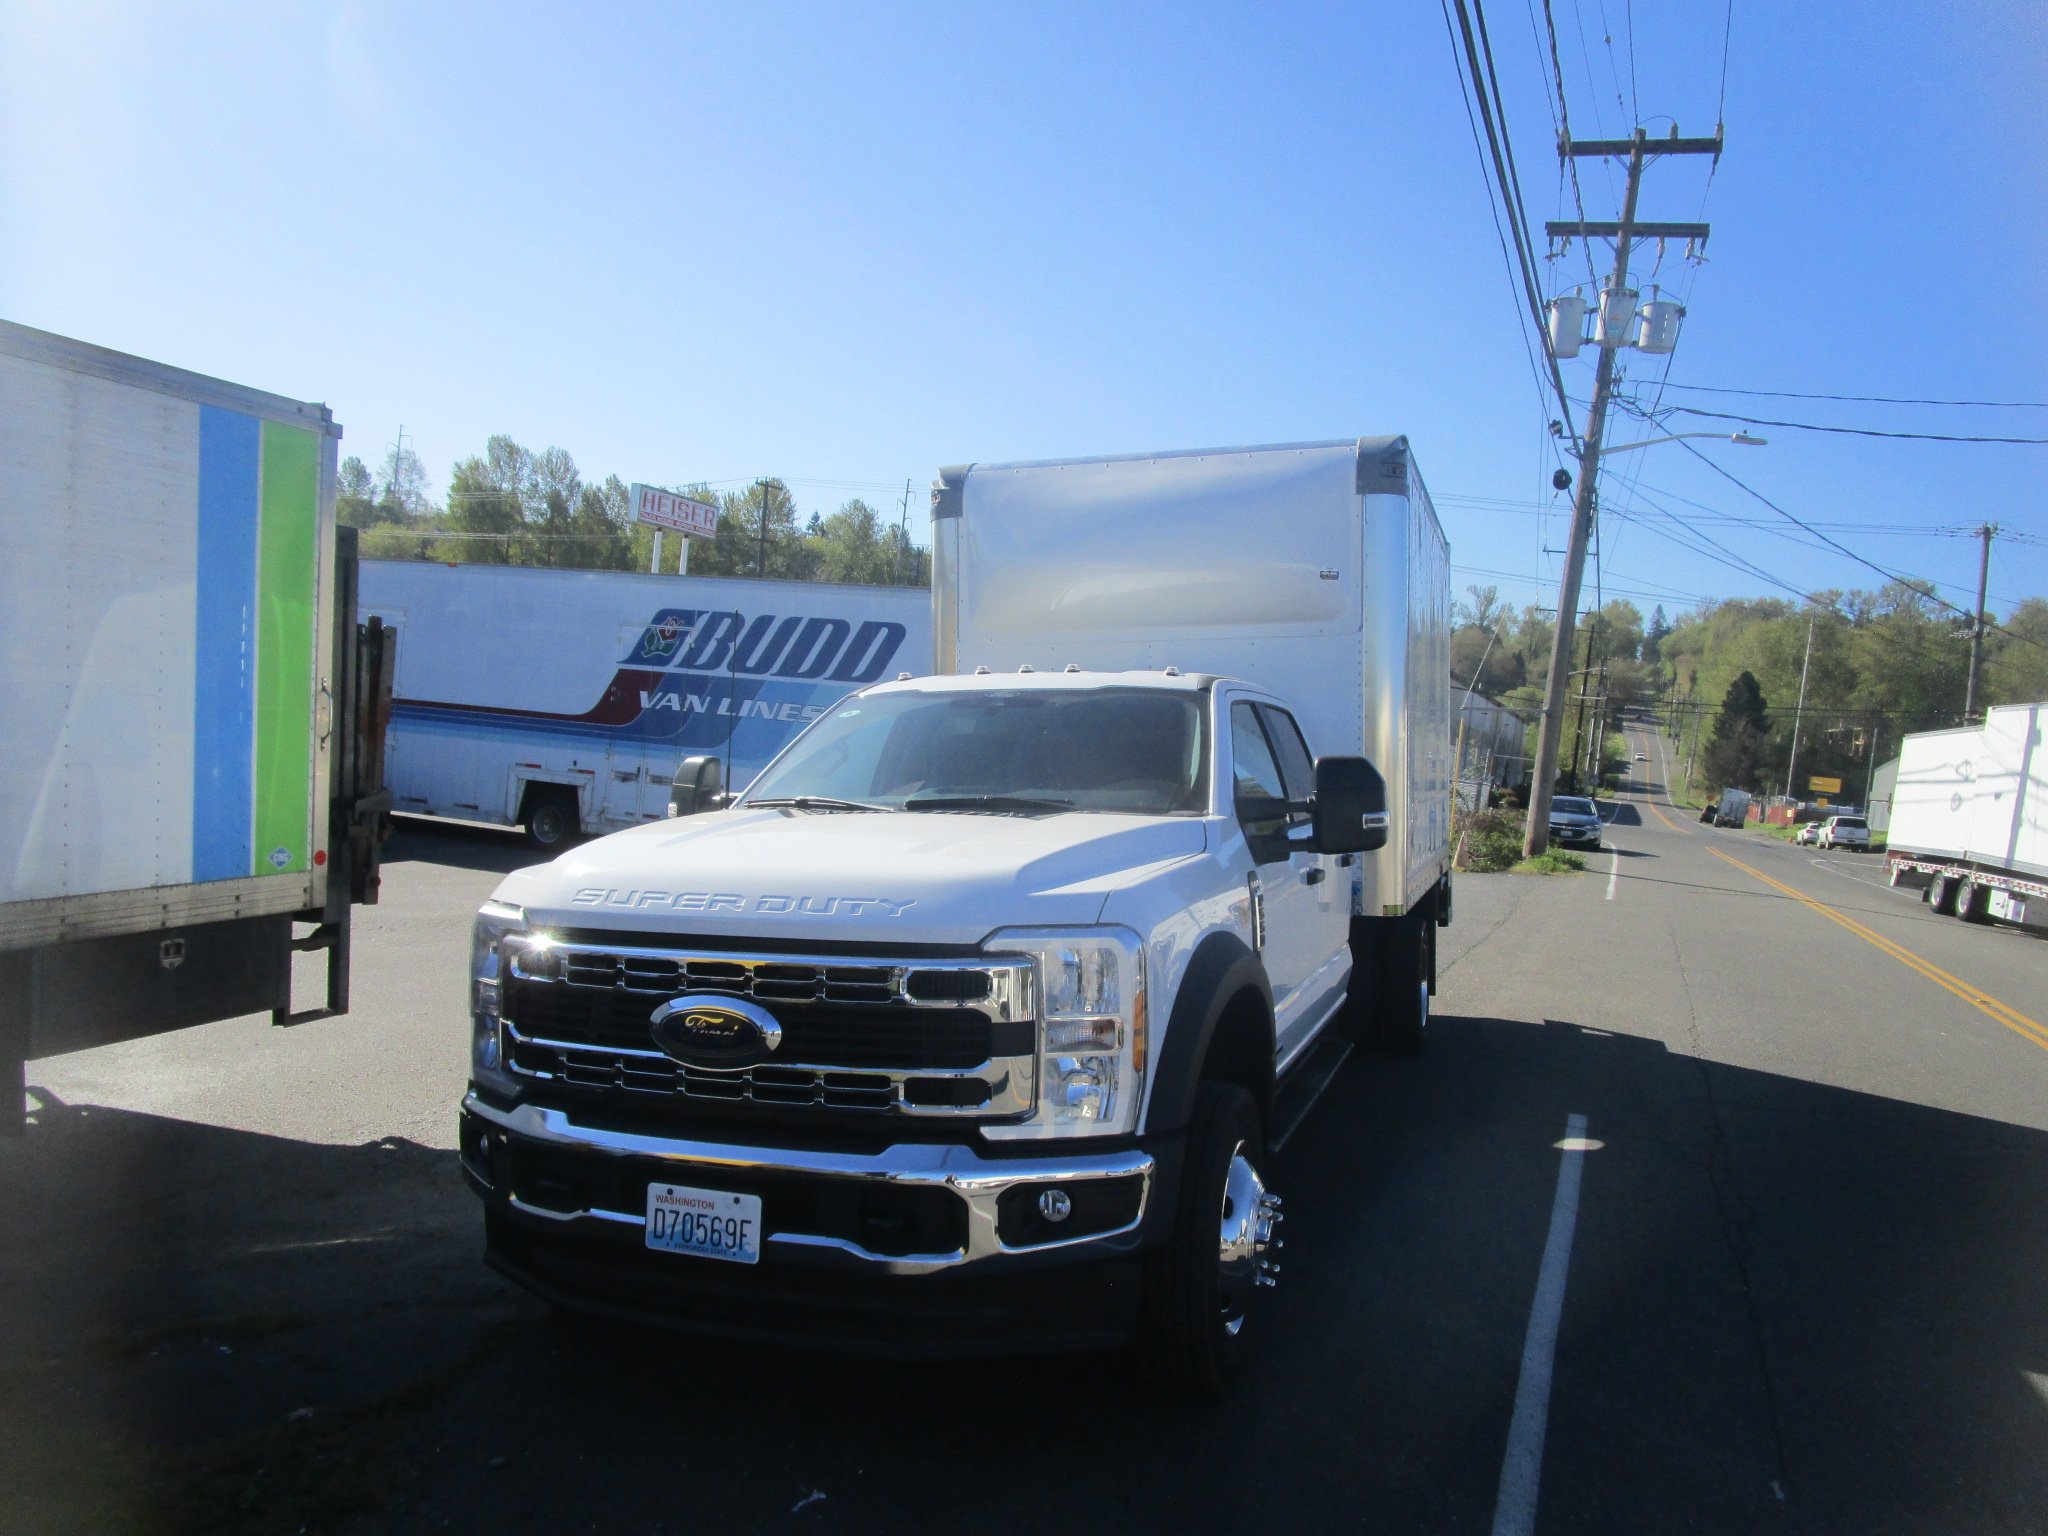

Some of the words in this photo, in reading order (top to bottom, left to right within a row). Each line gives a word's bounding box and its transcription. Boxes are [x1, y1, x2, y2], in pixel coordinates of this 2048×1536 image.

[642, 490, 715, 527] HEISER
[673, 610, 907, 683] BUDD
[639, 690, 711, 713] VAN
[716, 697, 827, 723] LINES
[572, 888, 746, 912] SUPER
[755, 894, 917, 917] DUTY
[655, 1195, 715, 1210] WASHINGTON
[653, 1208, 752, 1251] D70569F
